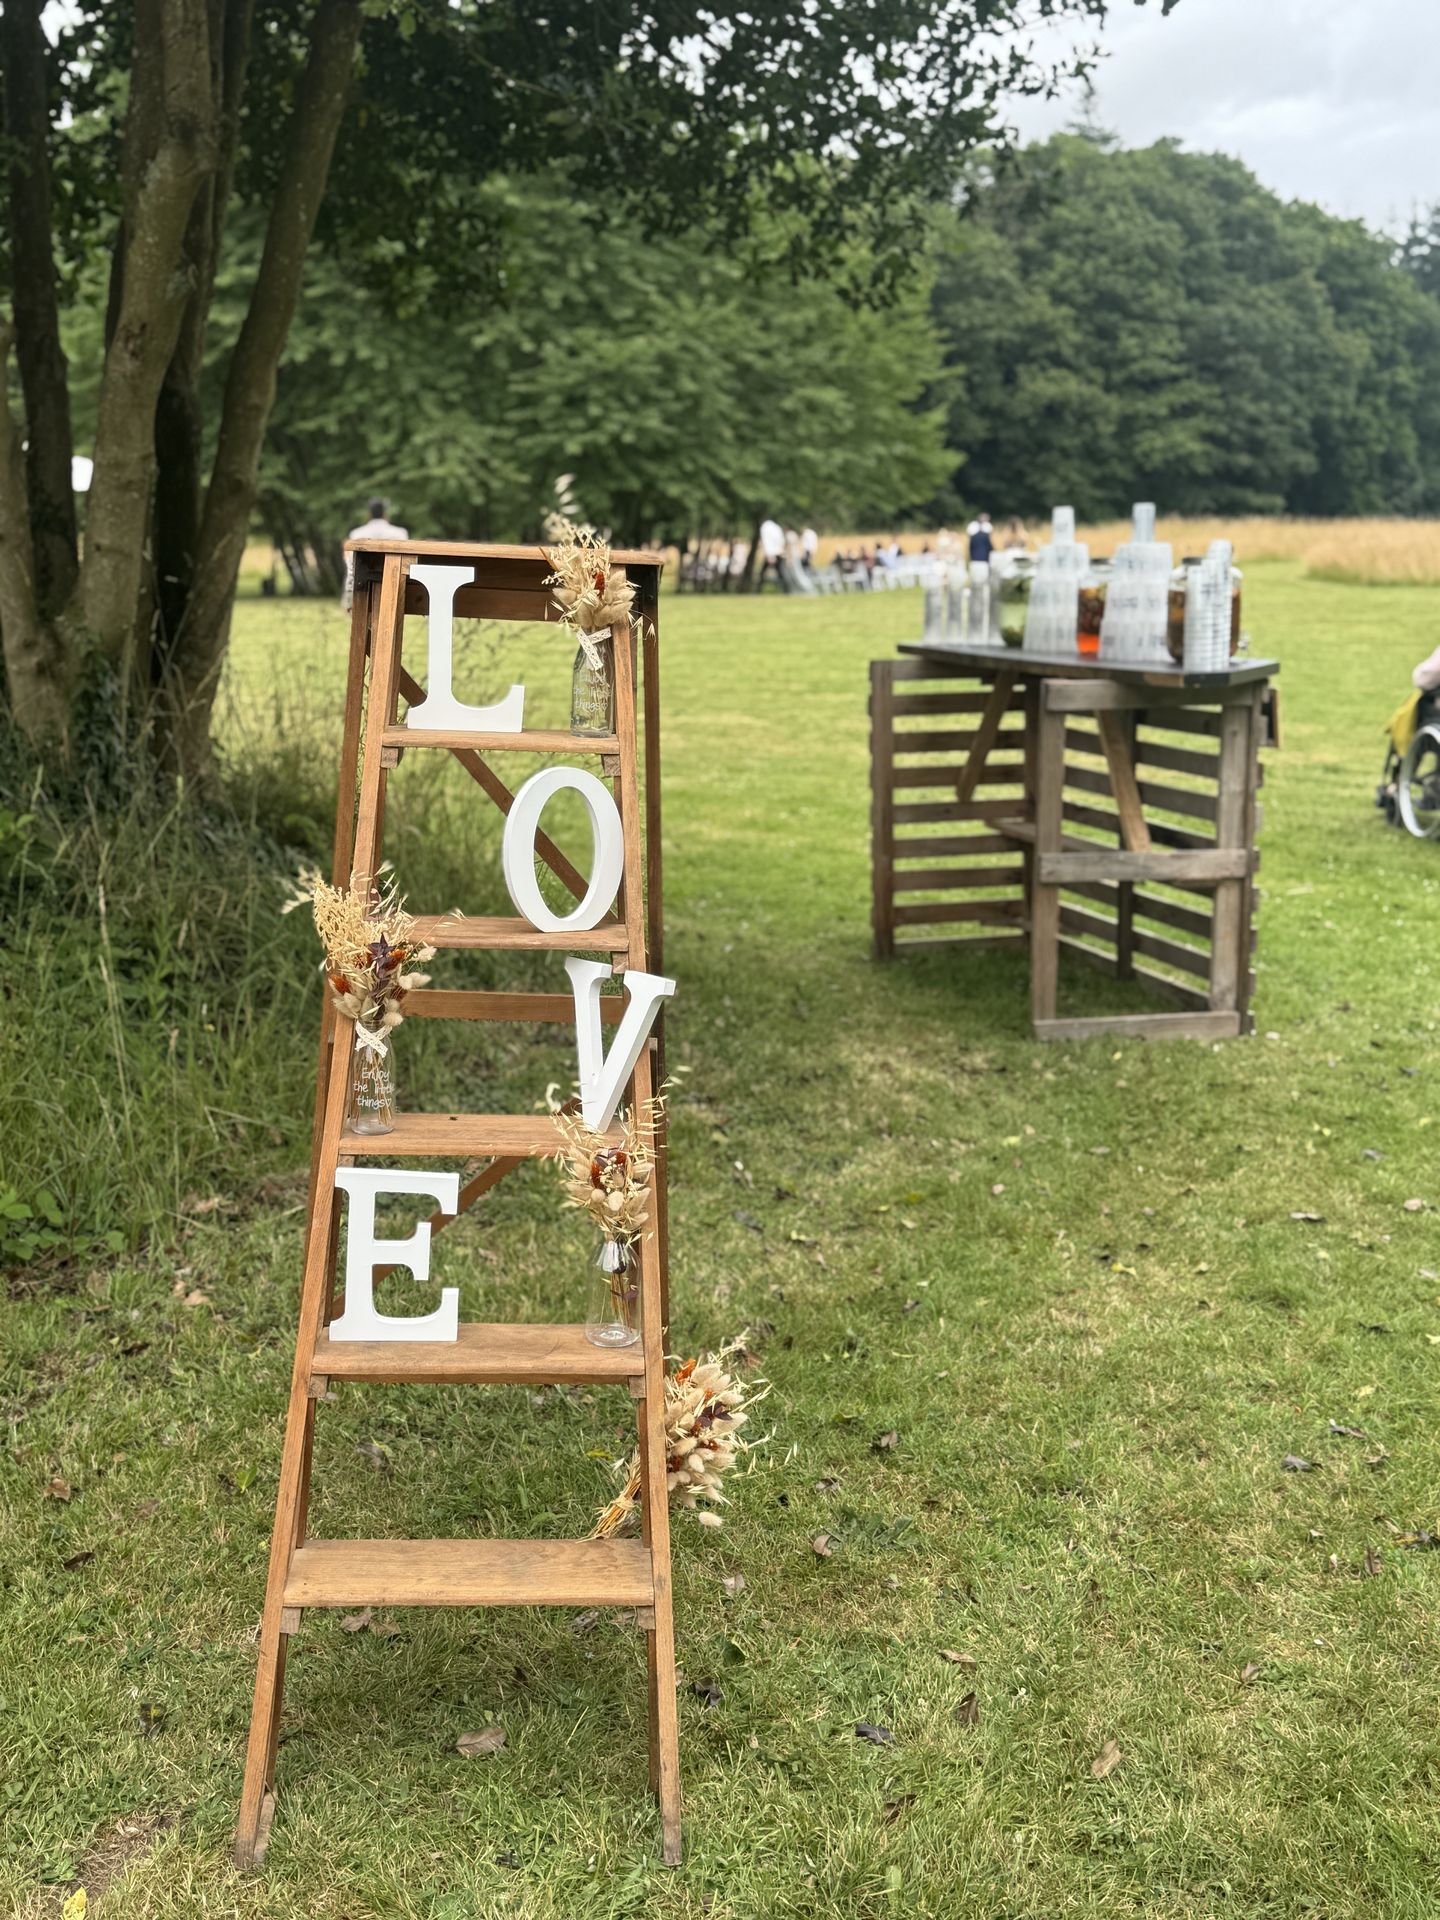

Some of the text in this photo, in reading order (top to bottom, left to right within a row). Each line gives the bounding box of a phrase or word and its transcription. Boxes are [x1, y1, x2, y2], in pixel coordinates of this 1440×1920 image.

[361, 1067, 390, 1082] Enjoy
[352, 1080, 369, 1093] the
[356, 1094, 386, 1110] things
